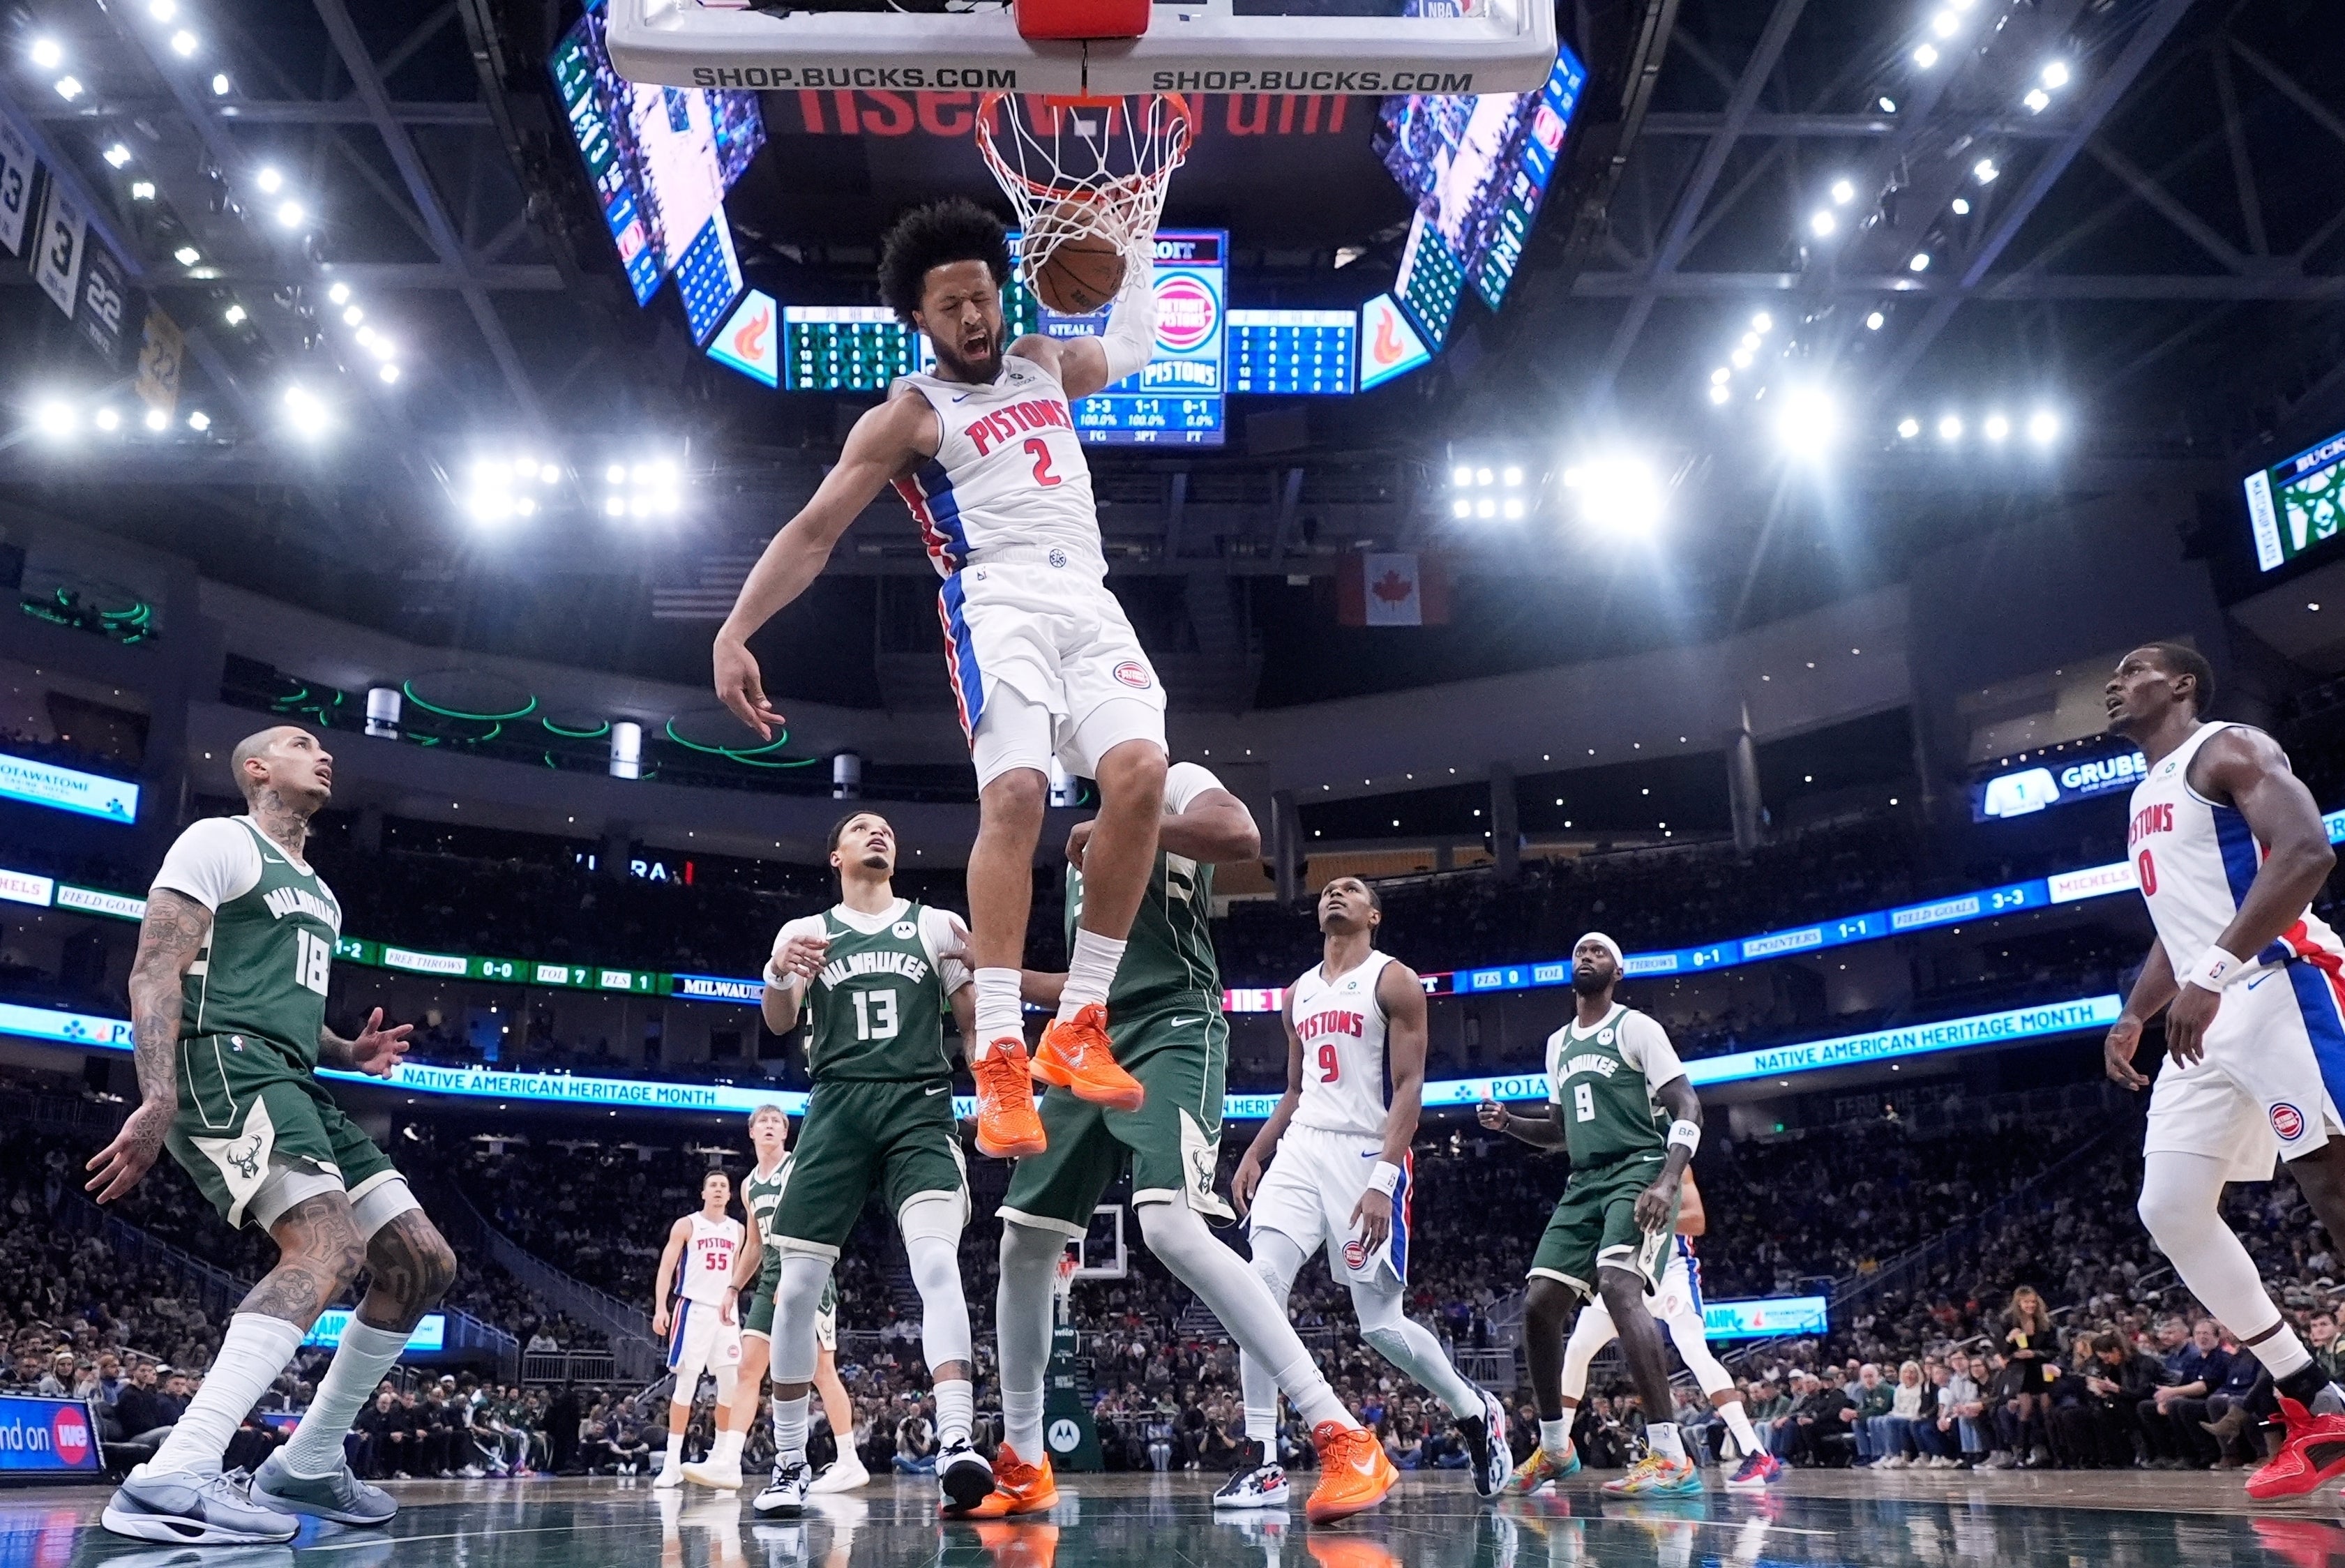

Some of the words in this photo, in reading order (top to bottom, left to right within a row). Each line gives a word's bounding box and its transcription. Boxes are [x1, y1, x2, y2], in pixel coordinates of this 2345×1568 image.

[1427, 1, 1454, 17] NBA
[693, 67, 1016, 89] SHOP.BUCKS.COM
[1152, 71, 1473, 92] SHOP.BUCKS.COM
[51, 220, 73, 277] 3
[1048, 323, 1095, 336] STEALS
[1144, 361, 1216, 386] PISTONS
[1085, 398, 1111, 413] 3-3
[1135, 399, 1159, 414] 1-1
[1182, 399, 1207, 414] 0-1
[965, 398, 1073, 457] PISTONS
[1088, 430, 1106, 442] FG
[1024, 438, 1062, 487] 2
[2060, 751, 2148, 788] GRUBE
[2058, 869, 2131, 894] MICHELS
[2138, 848, 2157, 898] 0
[63, 890, 102, 906] FIELD
[105, 900, 146, 917] GOAL
[1992, 889, 2024, 910] 3-3
[263, 887, 342, 938] MILWAUK
[1839, 920, 1867, 939] 1-1
[296, 928, 330, 997] 18
[388, 951, 416, 966] FREE
[416, 955, 463, 972] THROWS
[1693, 949, 1720, 967] 0-1
[483, 961, 513, 978] 0-0
[540, 968, 566, 981] TOL
[575, 970, 586, 984] 7
[605, 973, 629, 987] FLS
[818, 951, 928, 993] MILWAUKEE
[1477, 972, 1499, 986] FLS
[1509, 970, 1518, 983] 0
[640, 975, 648, 989] 1
[684, 978, 764, 1000] MILWAUK
[852, 988, 899, 1041] 13
[1296, 1010, 1364, 1041] PISTONS
[1754, 1046, 1818, 1071] NATIVE
[1821, 1033, 1918, 1063] AMERICAN
[1920, 1017, 2016, 1048] HERITAGE
[2021, 1003, 2094, 1031] MONTH
[1318, 1044, 1340, 1084] 9
[402, 1067, 466, 1090] NATIVE
[471, 1073, 564, 1097] AMERICAN
[568, 1081, 652, 1102] HERITAGE
[657, 1087, 716, 1106] MONTH
[1491, 1080, 1551, 1097] POTA
[1238, 1099, 1282, 1115] HERIT
[1574, 1082, 1595, 1123] 9
[1677, 1126, 1695, 1138] BP
[698, 1237, 734, 1252] PISTONS
[706, 1253, 727, 1270] 55
[26, 1426, 50, 1452] on
